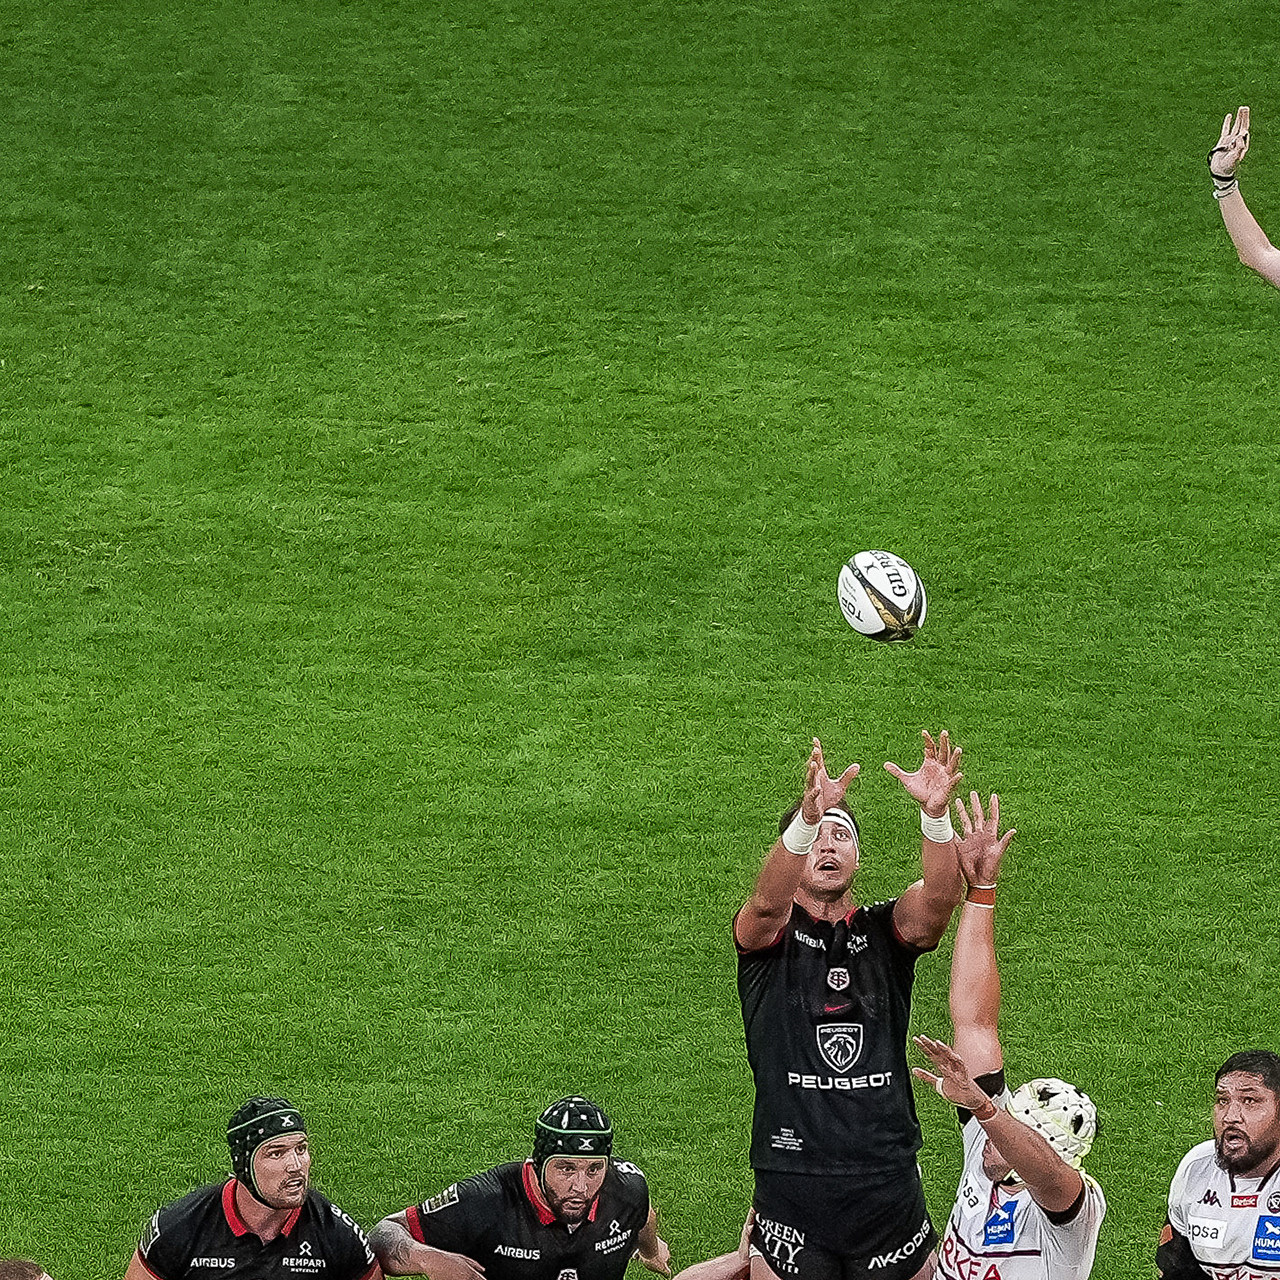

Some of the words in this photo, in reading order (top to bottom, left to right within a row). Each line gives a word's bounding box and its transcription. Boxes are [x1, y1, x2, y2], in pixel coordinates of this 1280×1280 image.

[794, 929, 827, 952] AIRBU
[787, 1071, 893, 1091] PEUGEOT
[1187, 1223, 1219, 1241] psa
[494, 1244, 541, 1260] AIRBUS
[190, 1257, 236, 1269] AIRBUS
